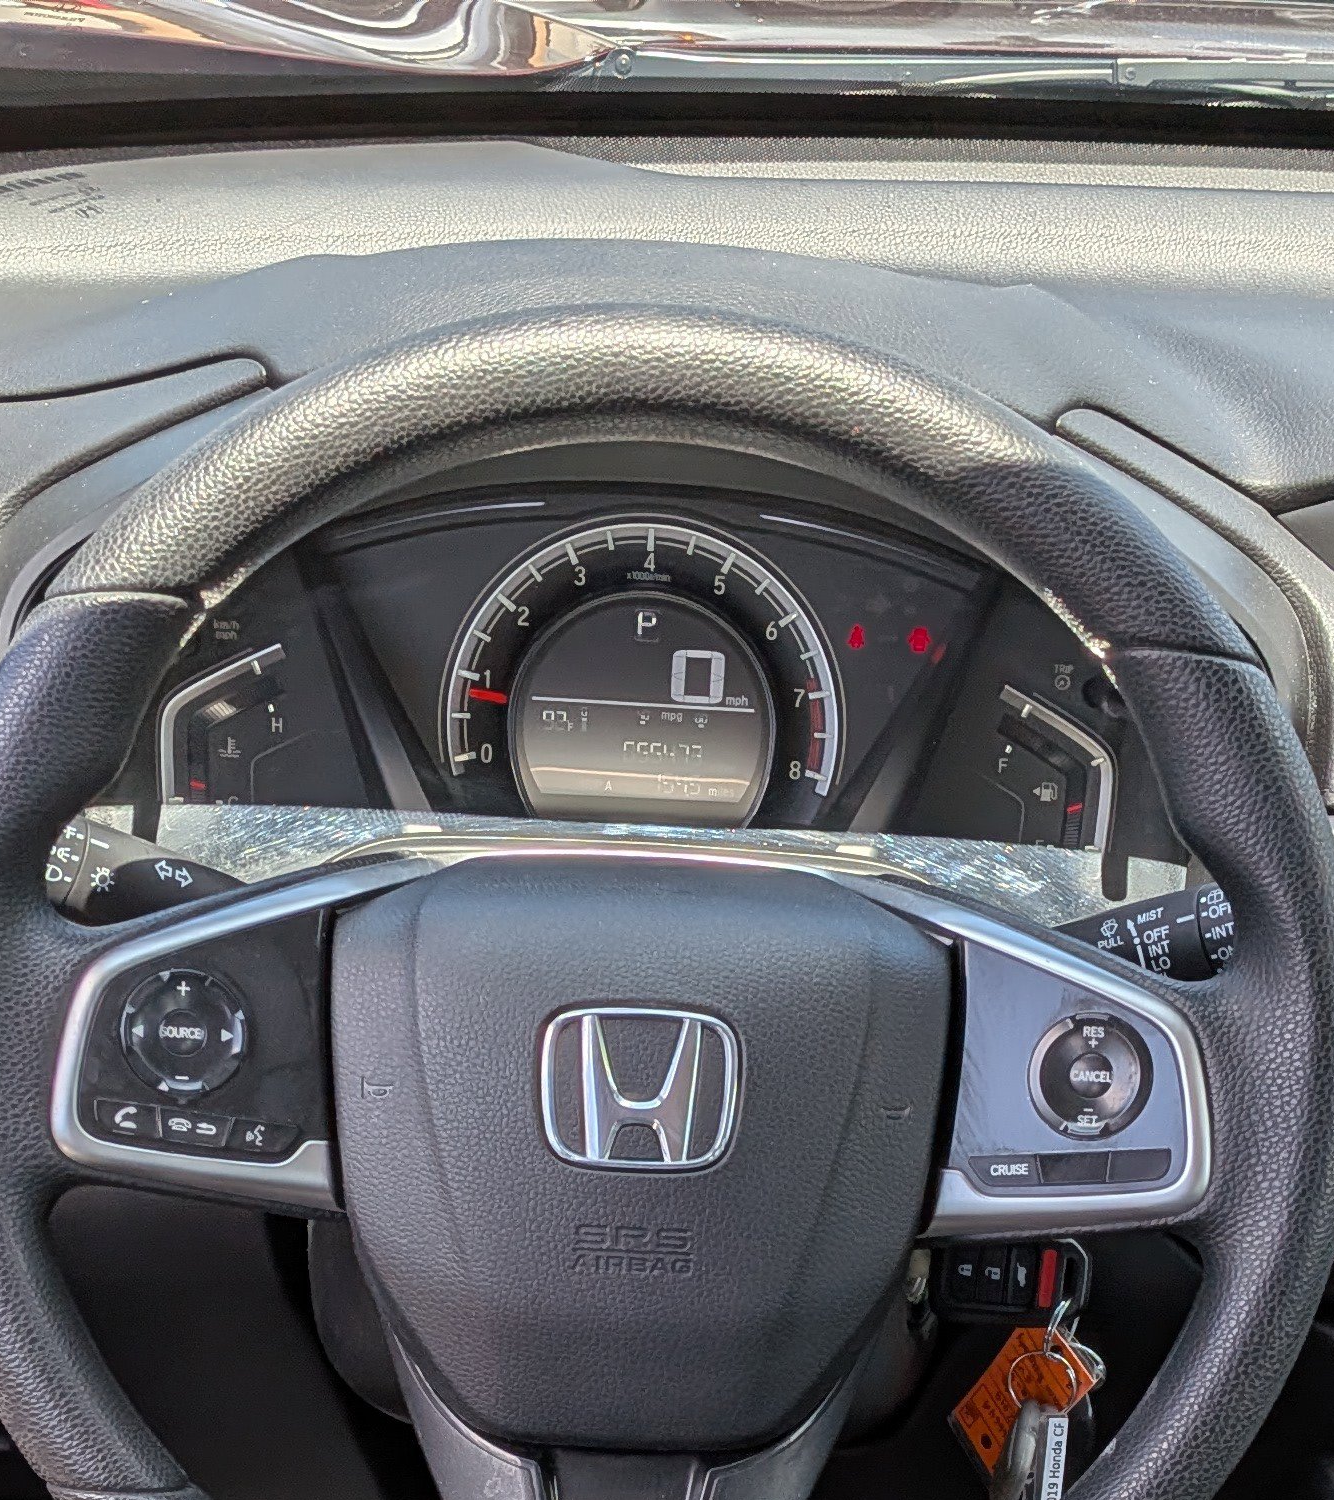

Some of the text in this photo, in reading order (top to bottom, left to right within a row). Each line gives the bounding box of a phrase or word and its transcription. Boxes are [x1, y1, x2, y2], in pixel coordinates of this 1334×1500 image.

[644, 553, 655, 571] 4
[574, 566, 586, 586] 3
[714, 575, 726, 595] 5
[517, 607, 530, 626] 2
[638, 612, 657, 634] P
[766, 623, 778, 641] 6
[484, 670, 491, 686] 1
[671, 650, 725, 704] 0
[726, 696, 748, 706] mph
[794, 690, 804, 707] 7
[661, 711, 683, 722] mpg
[272, 718, 283, 733] H
[481, 745, 493, 762] 0
[789, 761, 800, 780] 8
[998, 758, 1009, 774] F
[1137, 907, 1164, 925] MIST
[1143, 925, 1169, 944] OFF
[1211, 922, 1234, 940] INT
[1097, 936, 1124, 949] PULL
[1148, 940, 1170, 957] INT
[1151, 956, 1171, 972] LO
[159, 1024, 204, 1040] SOURCE
[1083, 1026, 1105, 1038] RES
[1070, 1070, 1113, 1083] CANCEL
[1077, 1114, 1098, 1126] SET
[990, 1163, 1029, 1176] CRUISE
[573, 1224, 694, 1249] SRS
[571, 1253, 694, 1275] AIRBAG
[1049, 1440, 1063, 1479] Honda
